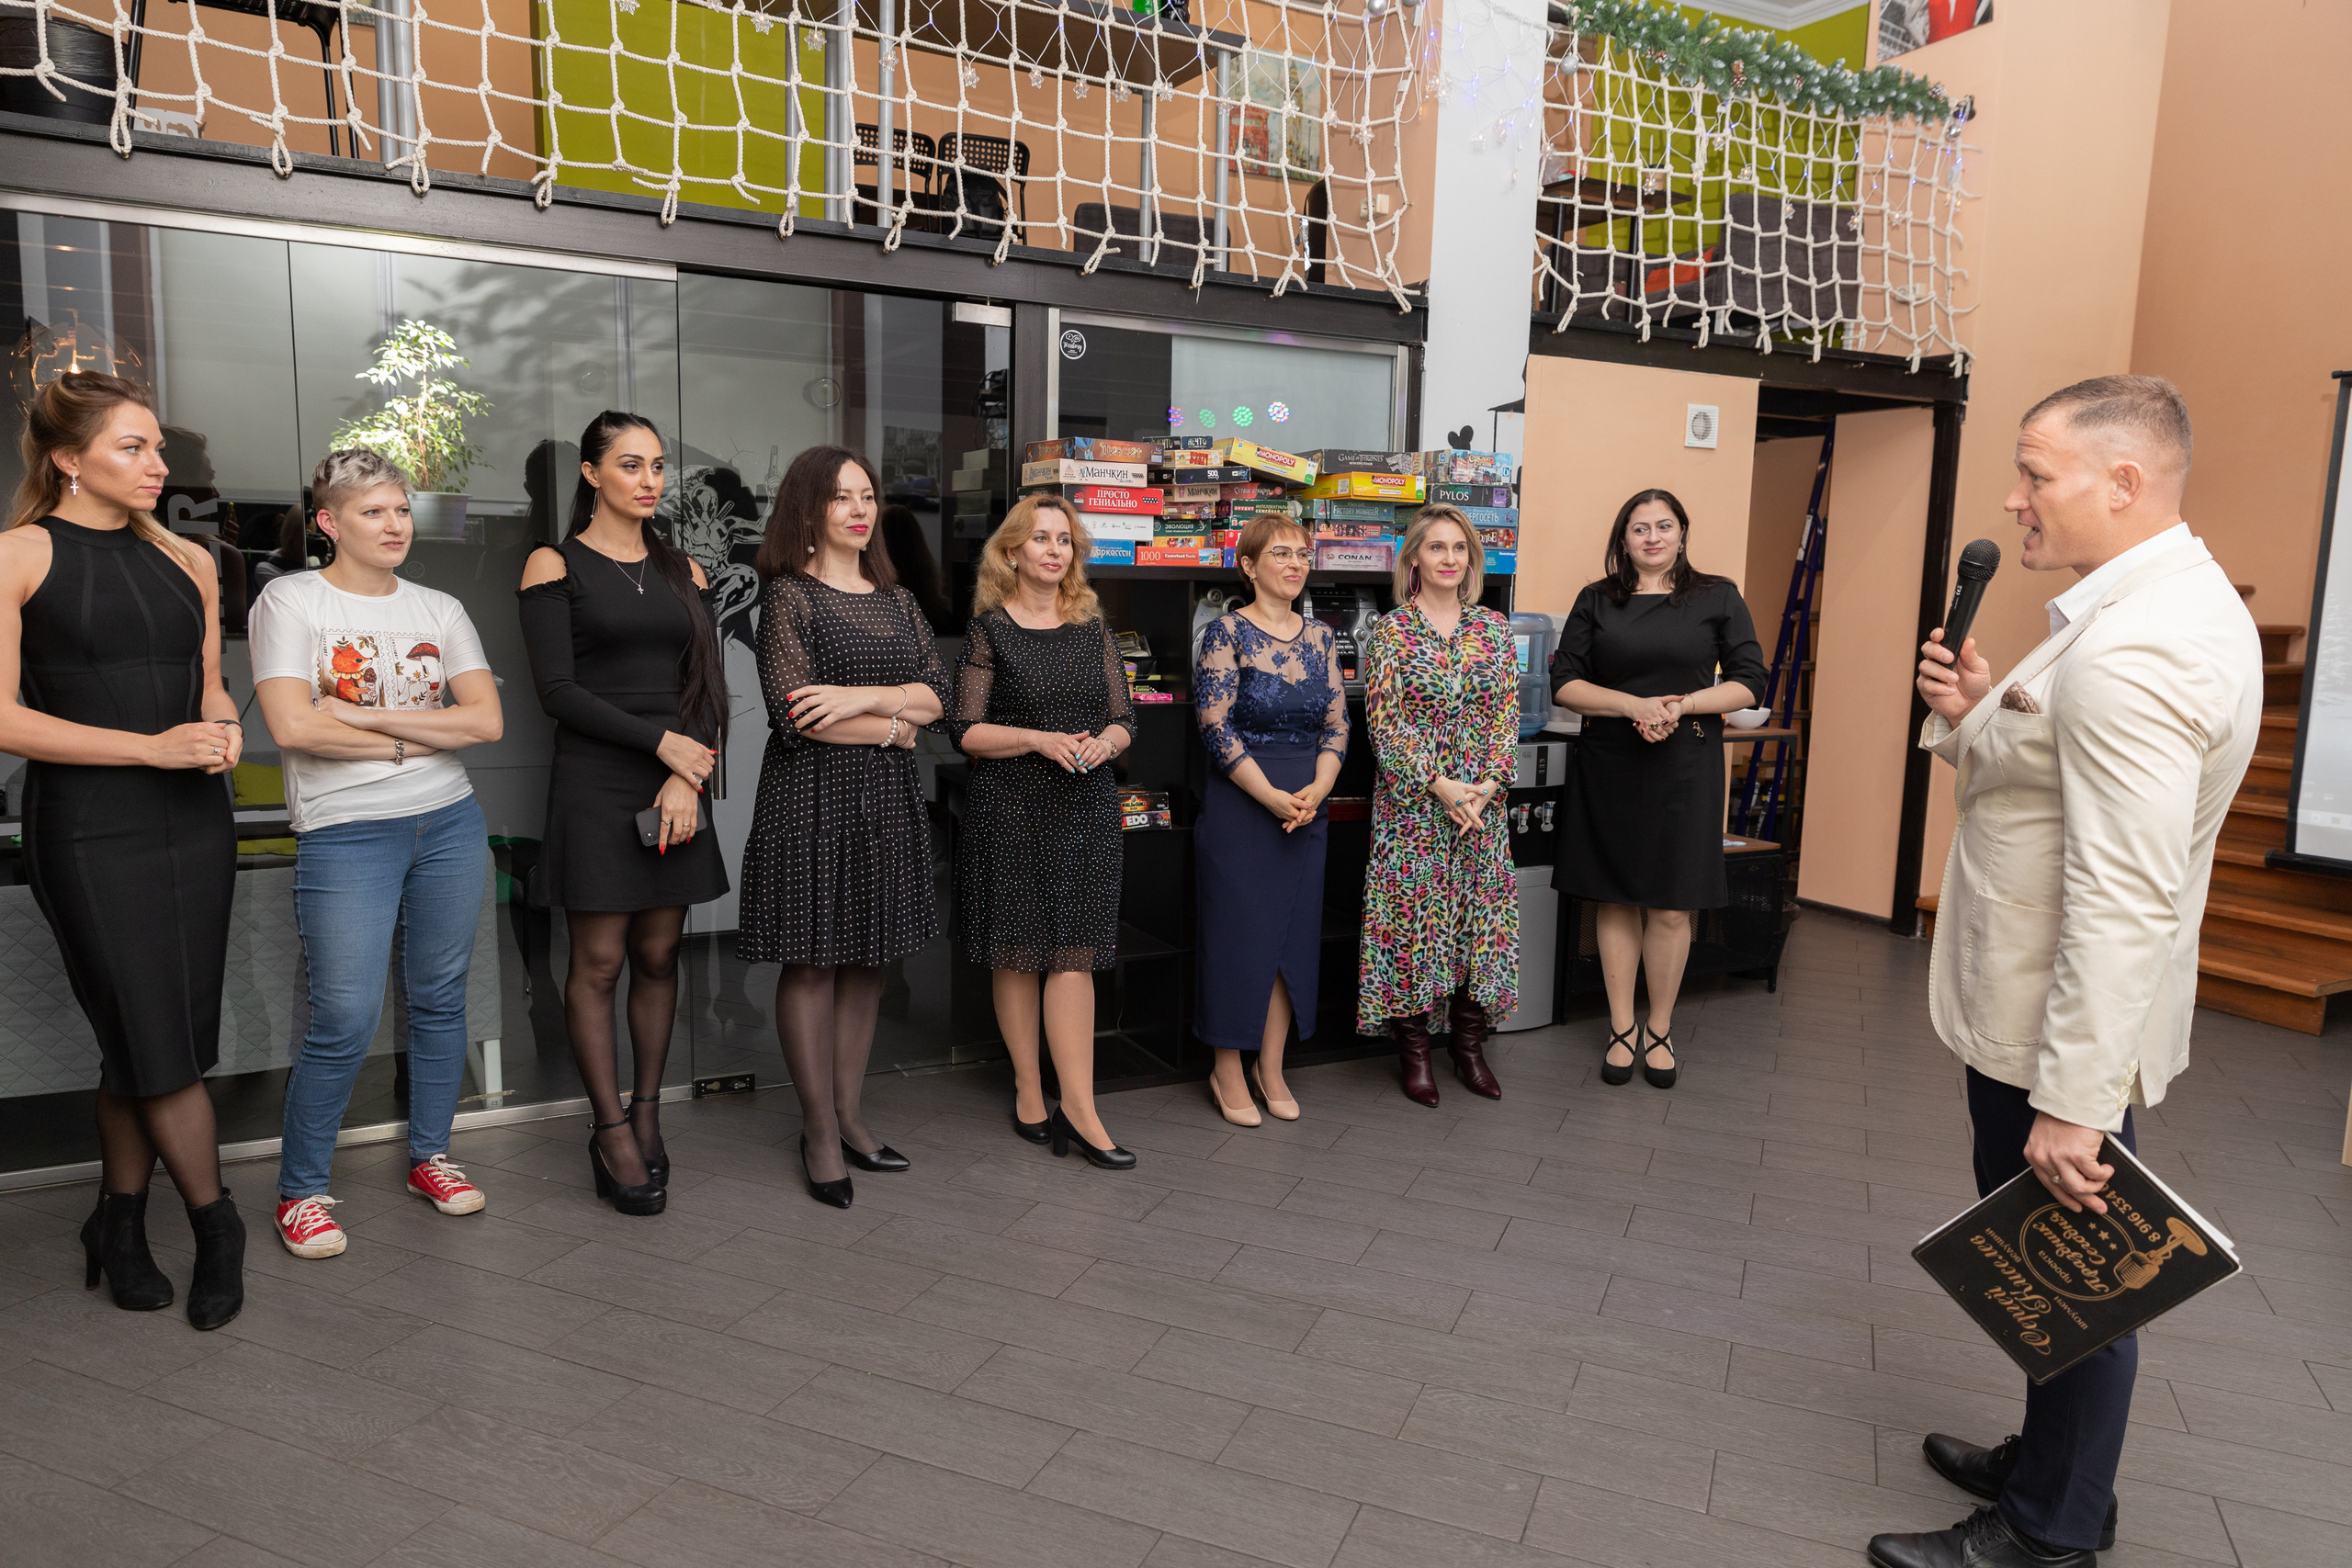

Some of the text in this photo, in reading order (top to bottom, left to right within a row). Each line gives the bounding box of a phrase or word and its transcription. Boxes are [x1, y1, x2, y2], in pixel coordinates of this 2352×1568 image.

[1259, 451, 1295, 466] MONOPOLY
[1086, 466, 1128, 480] Манчкин
[1374, 476, 1405, 485] MONOPOLY
[1097, 490, 1130, 499] ПРОСТО
[1187, 488, 1217, 497] Манчкин
[1440, 490, 1469, 501] PYLOS
[1089, 498, 1137, 508] ГЕНИАЛЬНО
[1333, 505, 1378, 516] FACTORY MANAGER
[1140, 551, 1161, 560] 1000
[2105, 1190, 2162, 1243] 8 916 334
[2050, 1210, 2107, 1265] Сегодня
[2032, 1222, 2109, 1293] Праздник
[2038, 1250, 2073, 1284] проекта
[1970, 1235, 2052, 1314] Киселев
[1984, 1285, 2052, 1356] Сергей
